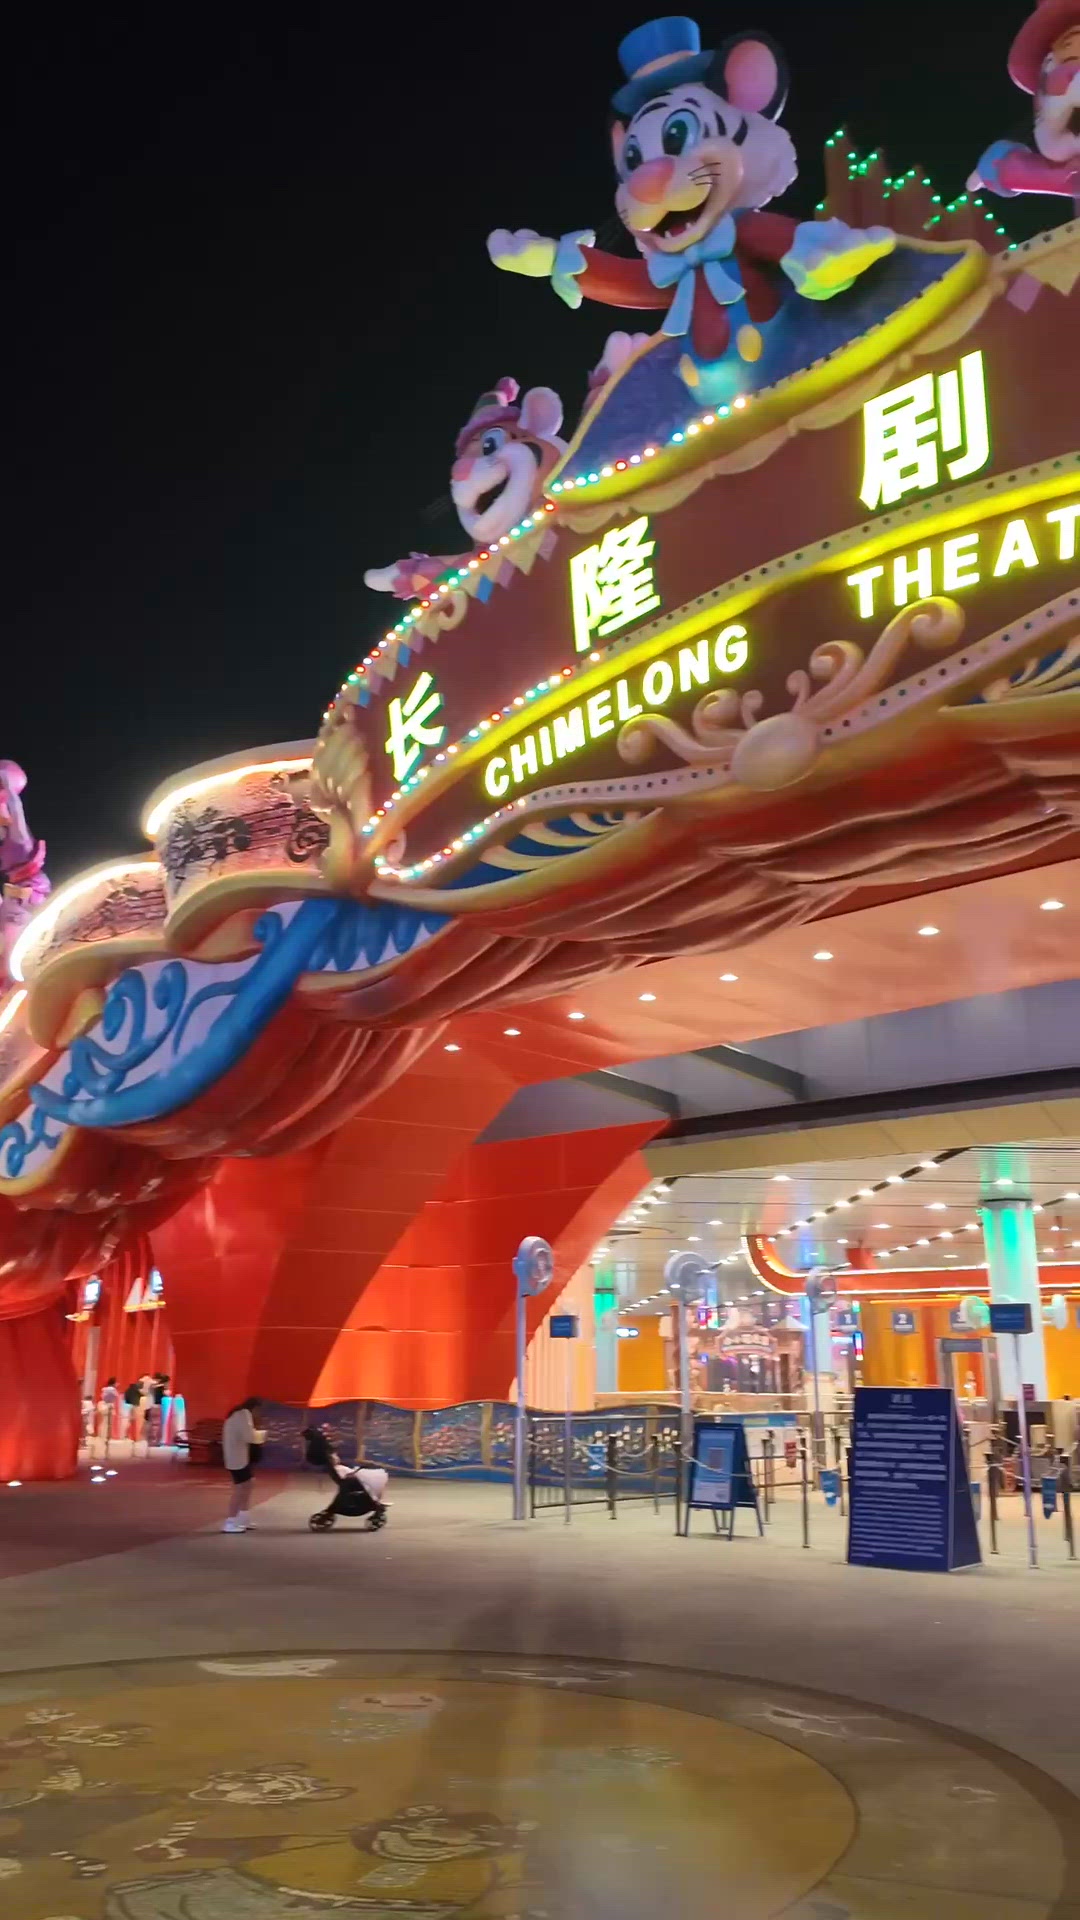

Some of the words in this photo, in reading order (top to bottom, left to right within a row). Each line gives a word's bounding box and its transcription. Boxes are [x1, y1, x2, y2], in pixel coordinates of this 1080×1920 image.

[484, 624, 749, 798] CHIMELONG
[846, 503, 1080, 620] THEAT
[897, 1313, 907, 1325] 2
